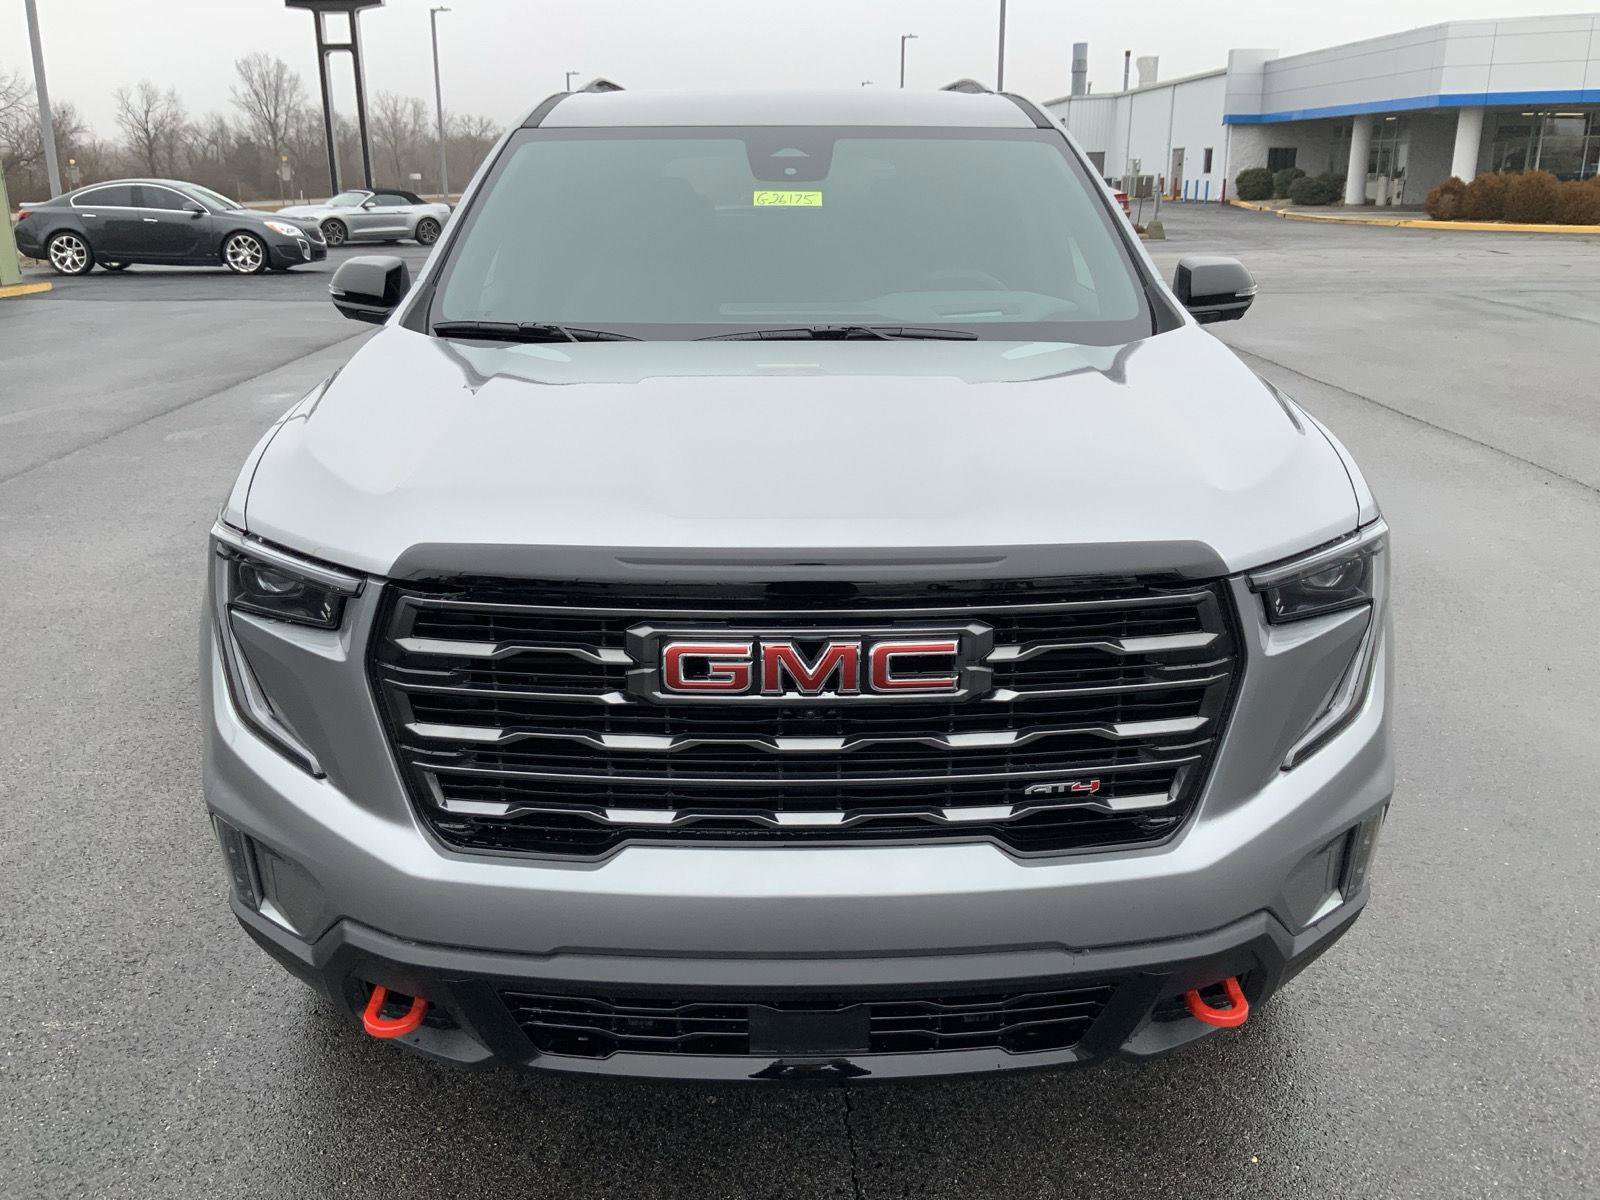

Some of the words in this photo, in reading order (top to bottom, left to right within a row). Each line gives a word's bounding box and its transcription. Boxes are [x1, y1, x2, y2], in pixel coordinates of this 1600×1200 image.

[756, 192, 817, 205] G26175
[662, 639, 960, 694] GMC
[1024, 779, 1101, 795] AT4
